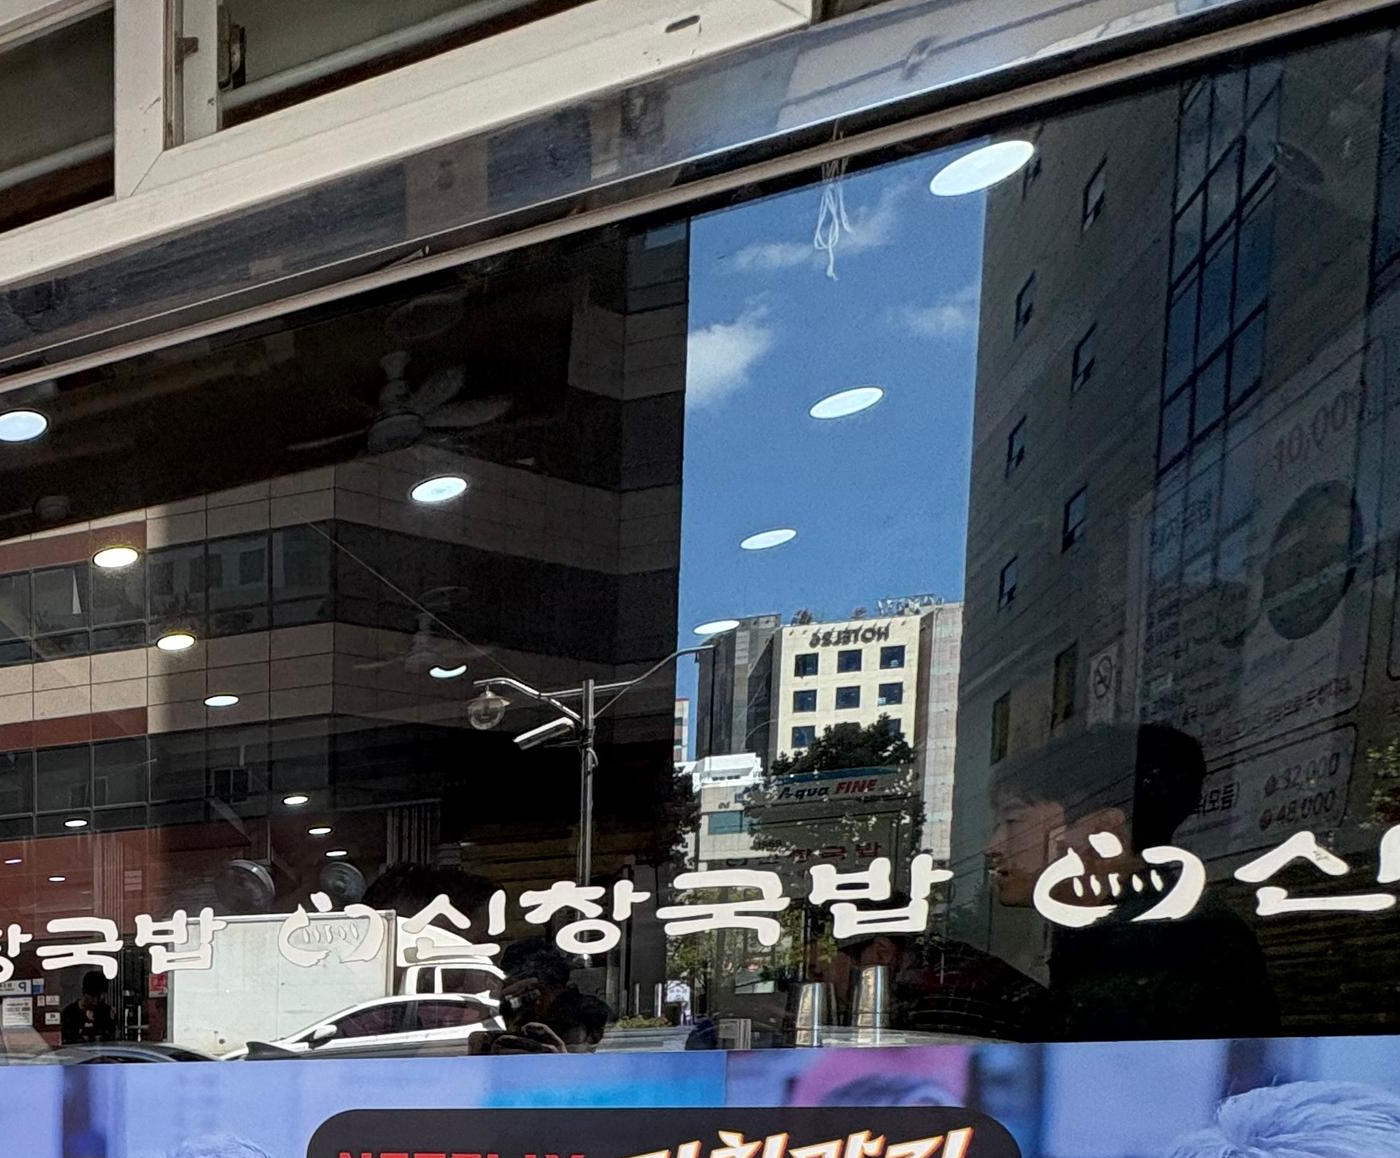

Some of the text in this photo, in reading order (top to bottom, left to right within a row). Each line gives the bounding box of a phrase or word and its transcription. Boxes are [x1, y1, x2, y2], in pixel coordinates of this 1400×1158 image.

[778, 779, 878, 801] Aqua FINE
[397, 852, 954, 966] 신창국밥
